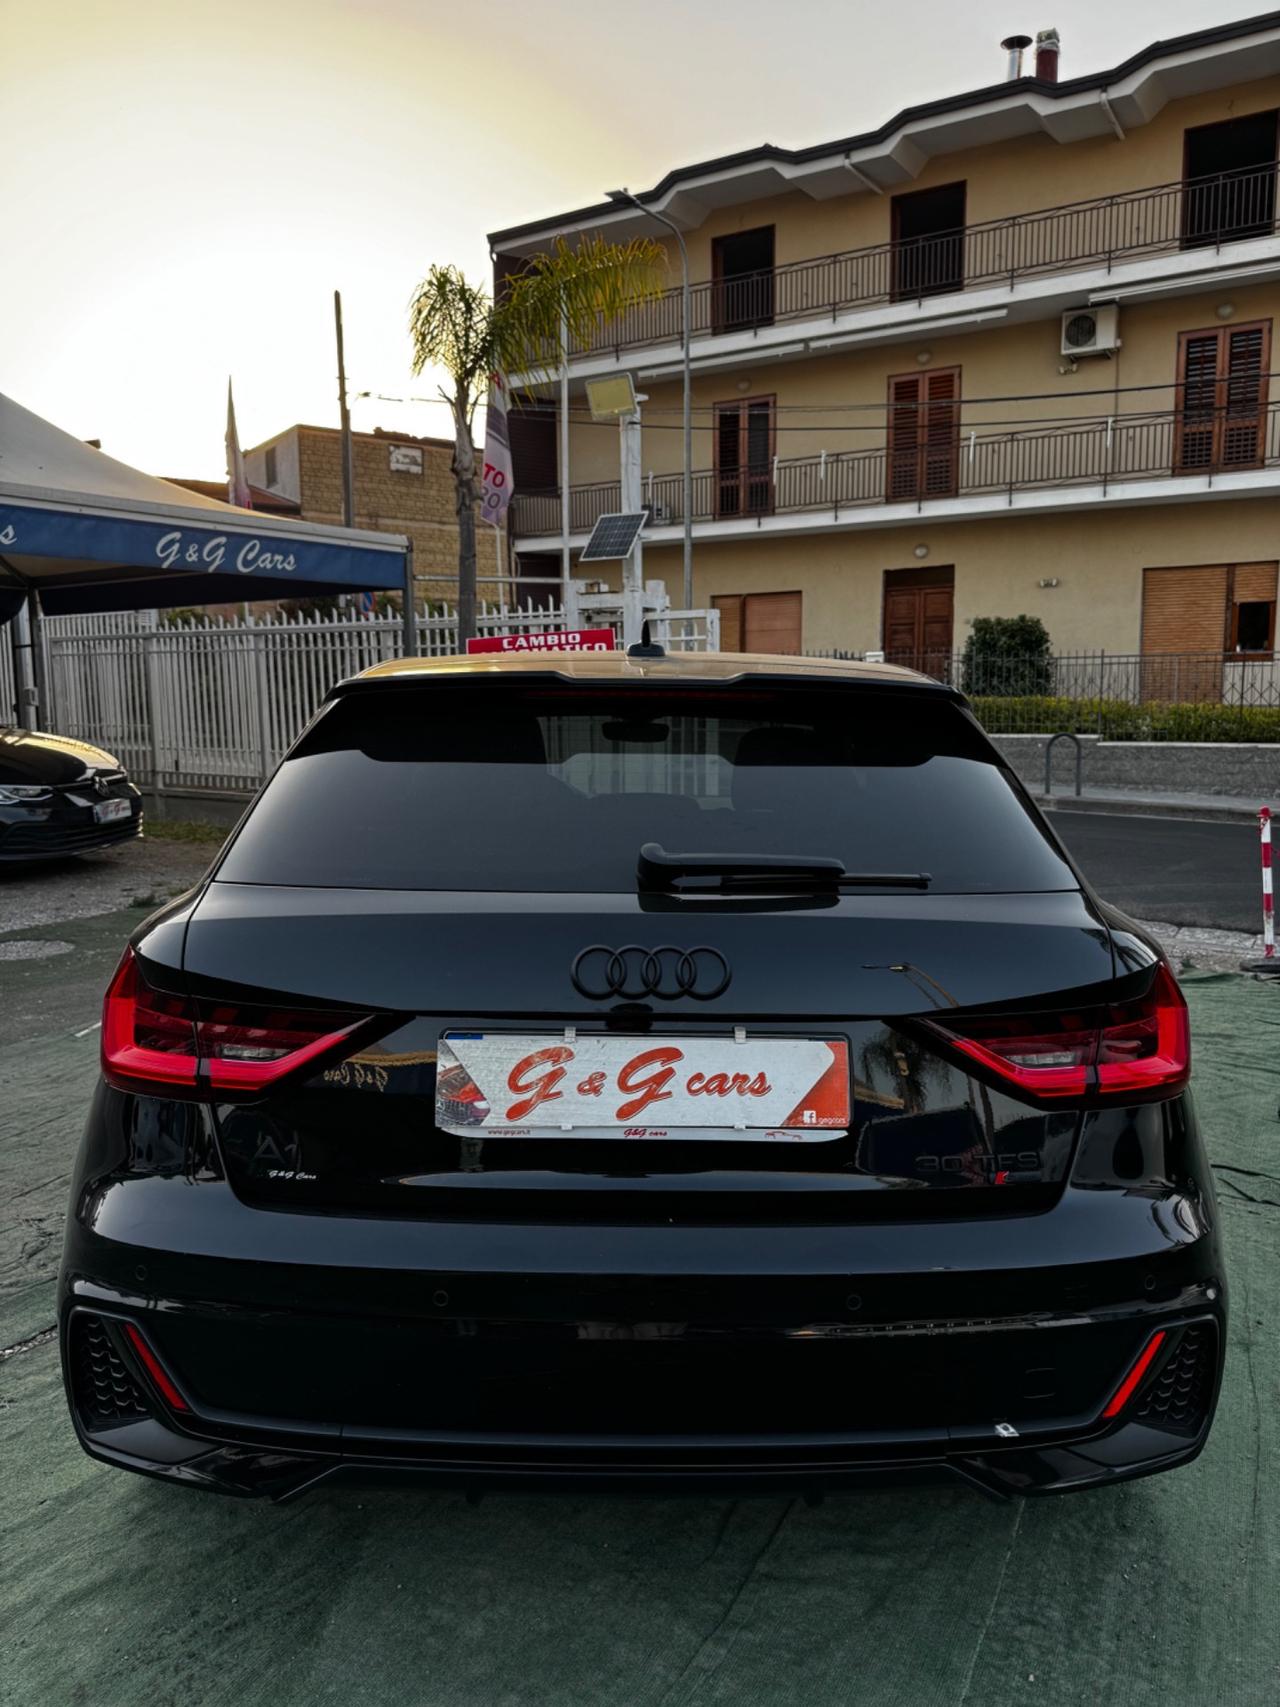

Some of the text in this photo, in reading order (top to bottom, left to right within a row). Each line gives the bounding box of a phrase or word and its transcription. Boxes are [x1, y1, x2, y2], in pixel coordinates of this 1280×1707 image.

[235, 539, 297, 574] Cars
[502, 633, 581, 649] CAMBIO
[685, 1071, 773, 1097] cars
[915, 1155, 963, 1173] 30
